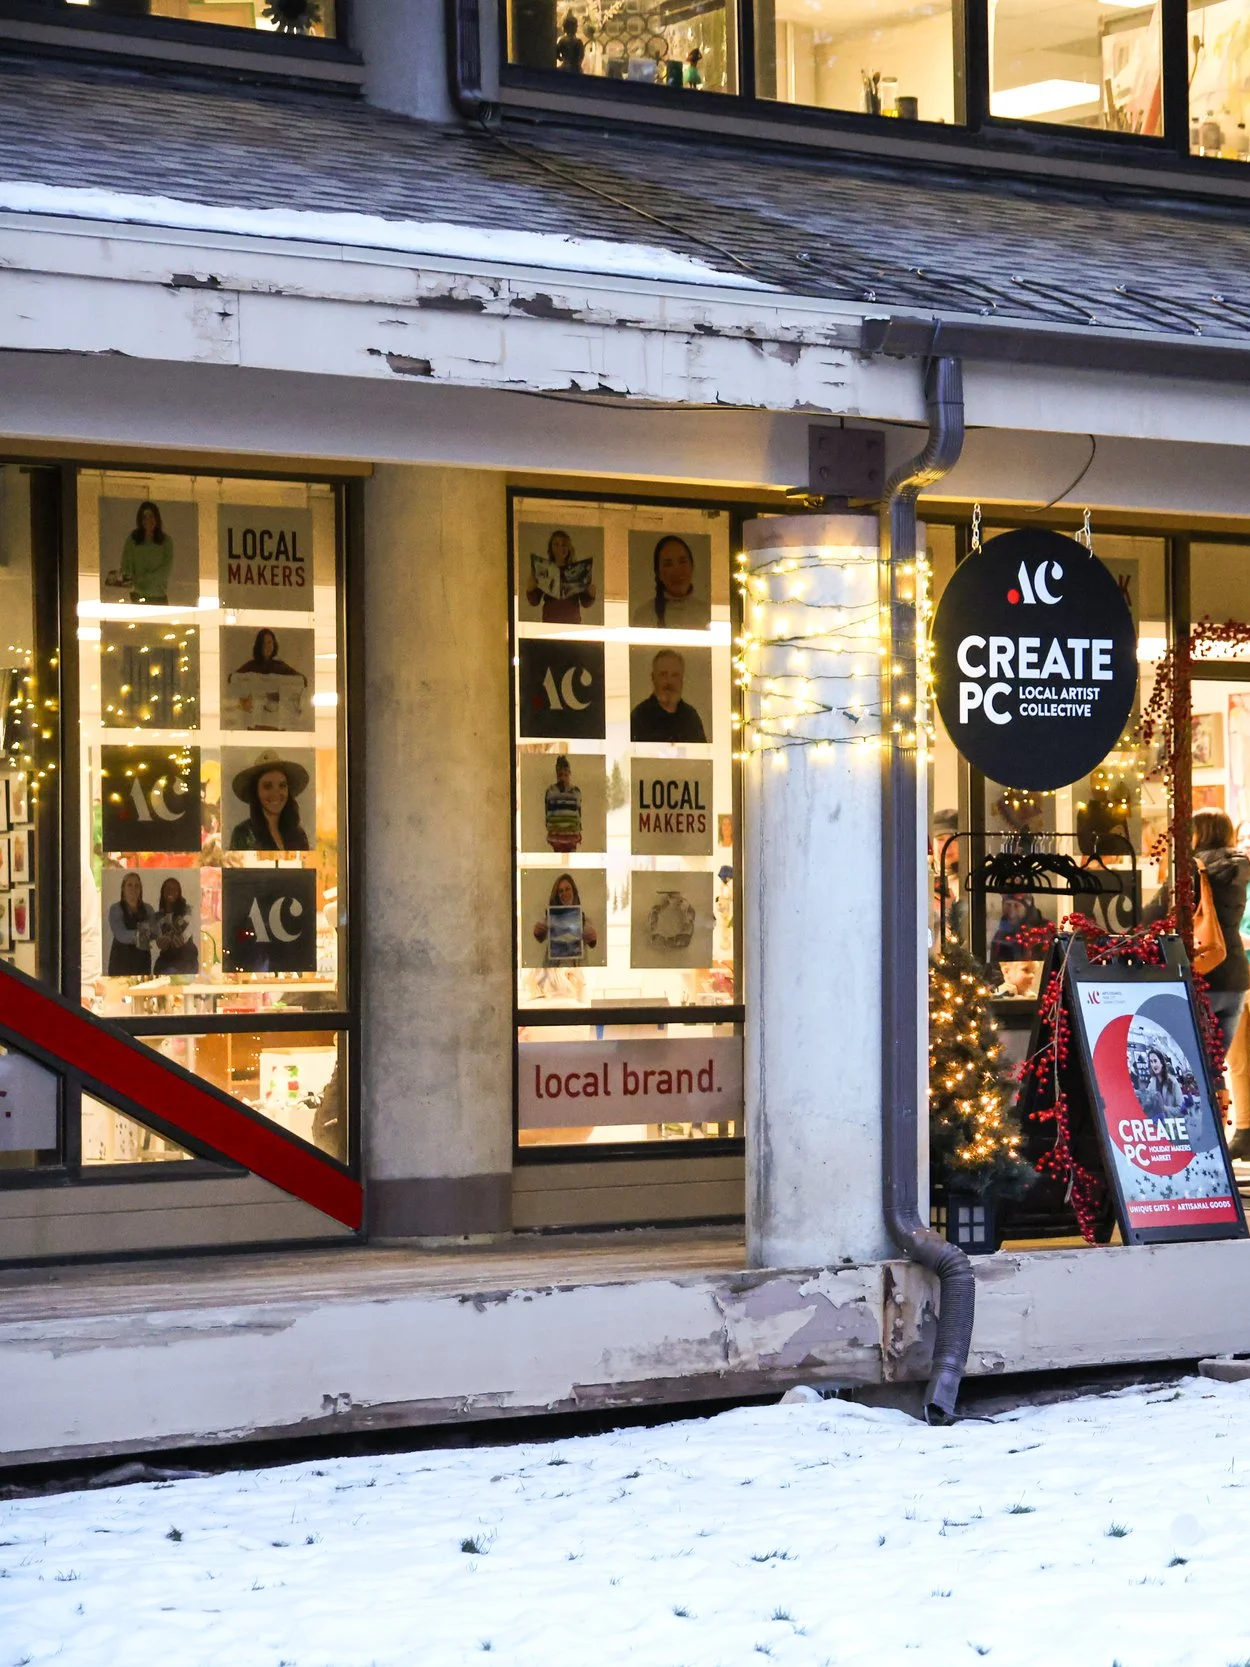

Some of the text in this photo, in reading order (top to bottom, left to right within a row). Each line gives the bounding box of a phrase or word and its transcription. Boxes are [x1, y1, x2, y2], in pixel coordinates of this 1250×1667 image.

[227, 527, 305, 562] LOCAL
[227, 563, 305, 587] MAKERS
[1007, 560, 1064, 605] AC
[957, 635, 1113, 680] CREATE
[959, 682, 1013, 725] PC
[1019, 686, 1101, 701] LOCAL ARTIST
[1019, 703, 1092, 717] COLLECTIVE
[639, 779, 706, 810] LOCAL
[639, 812, 706, 833] MAKERS
[535, 1059, 723, 1099] local brand.
[1119, 1118, 1189, 1142] CREATE
[1123, 1143, 1150, 1166] PC
[1149, 1144, 1191, 1153] HOLIDAY MAKERS
[1129, 1200, 1231, 1214] UNIQUE GIFTS ARTISANAL GOODS
